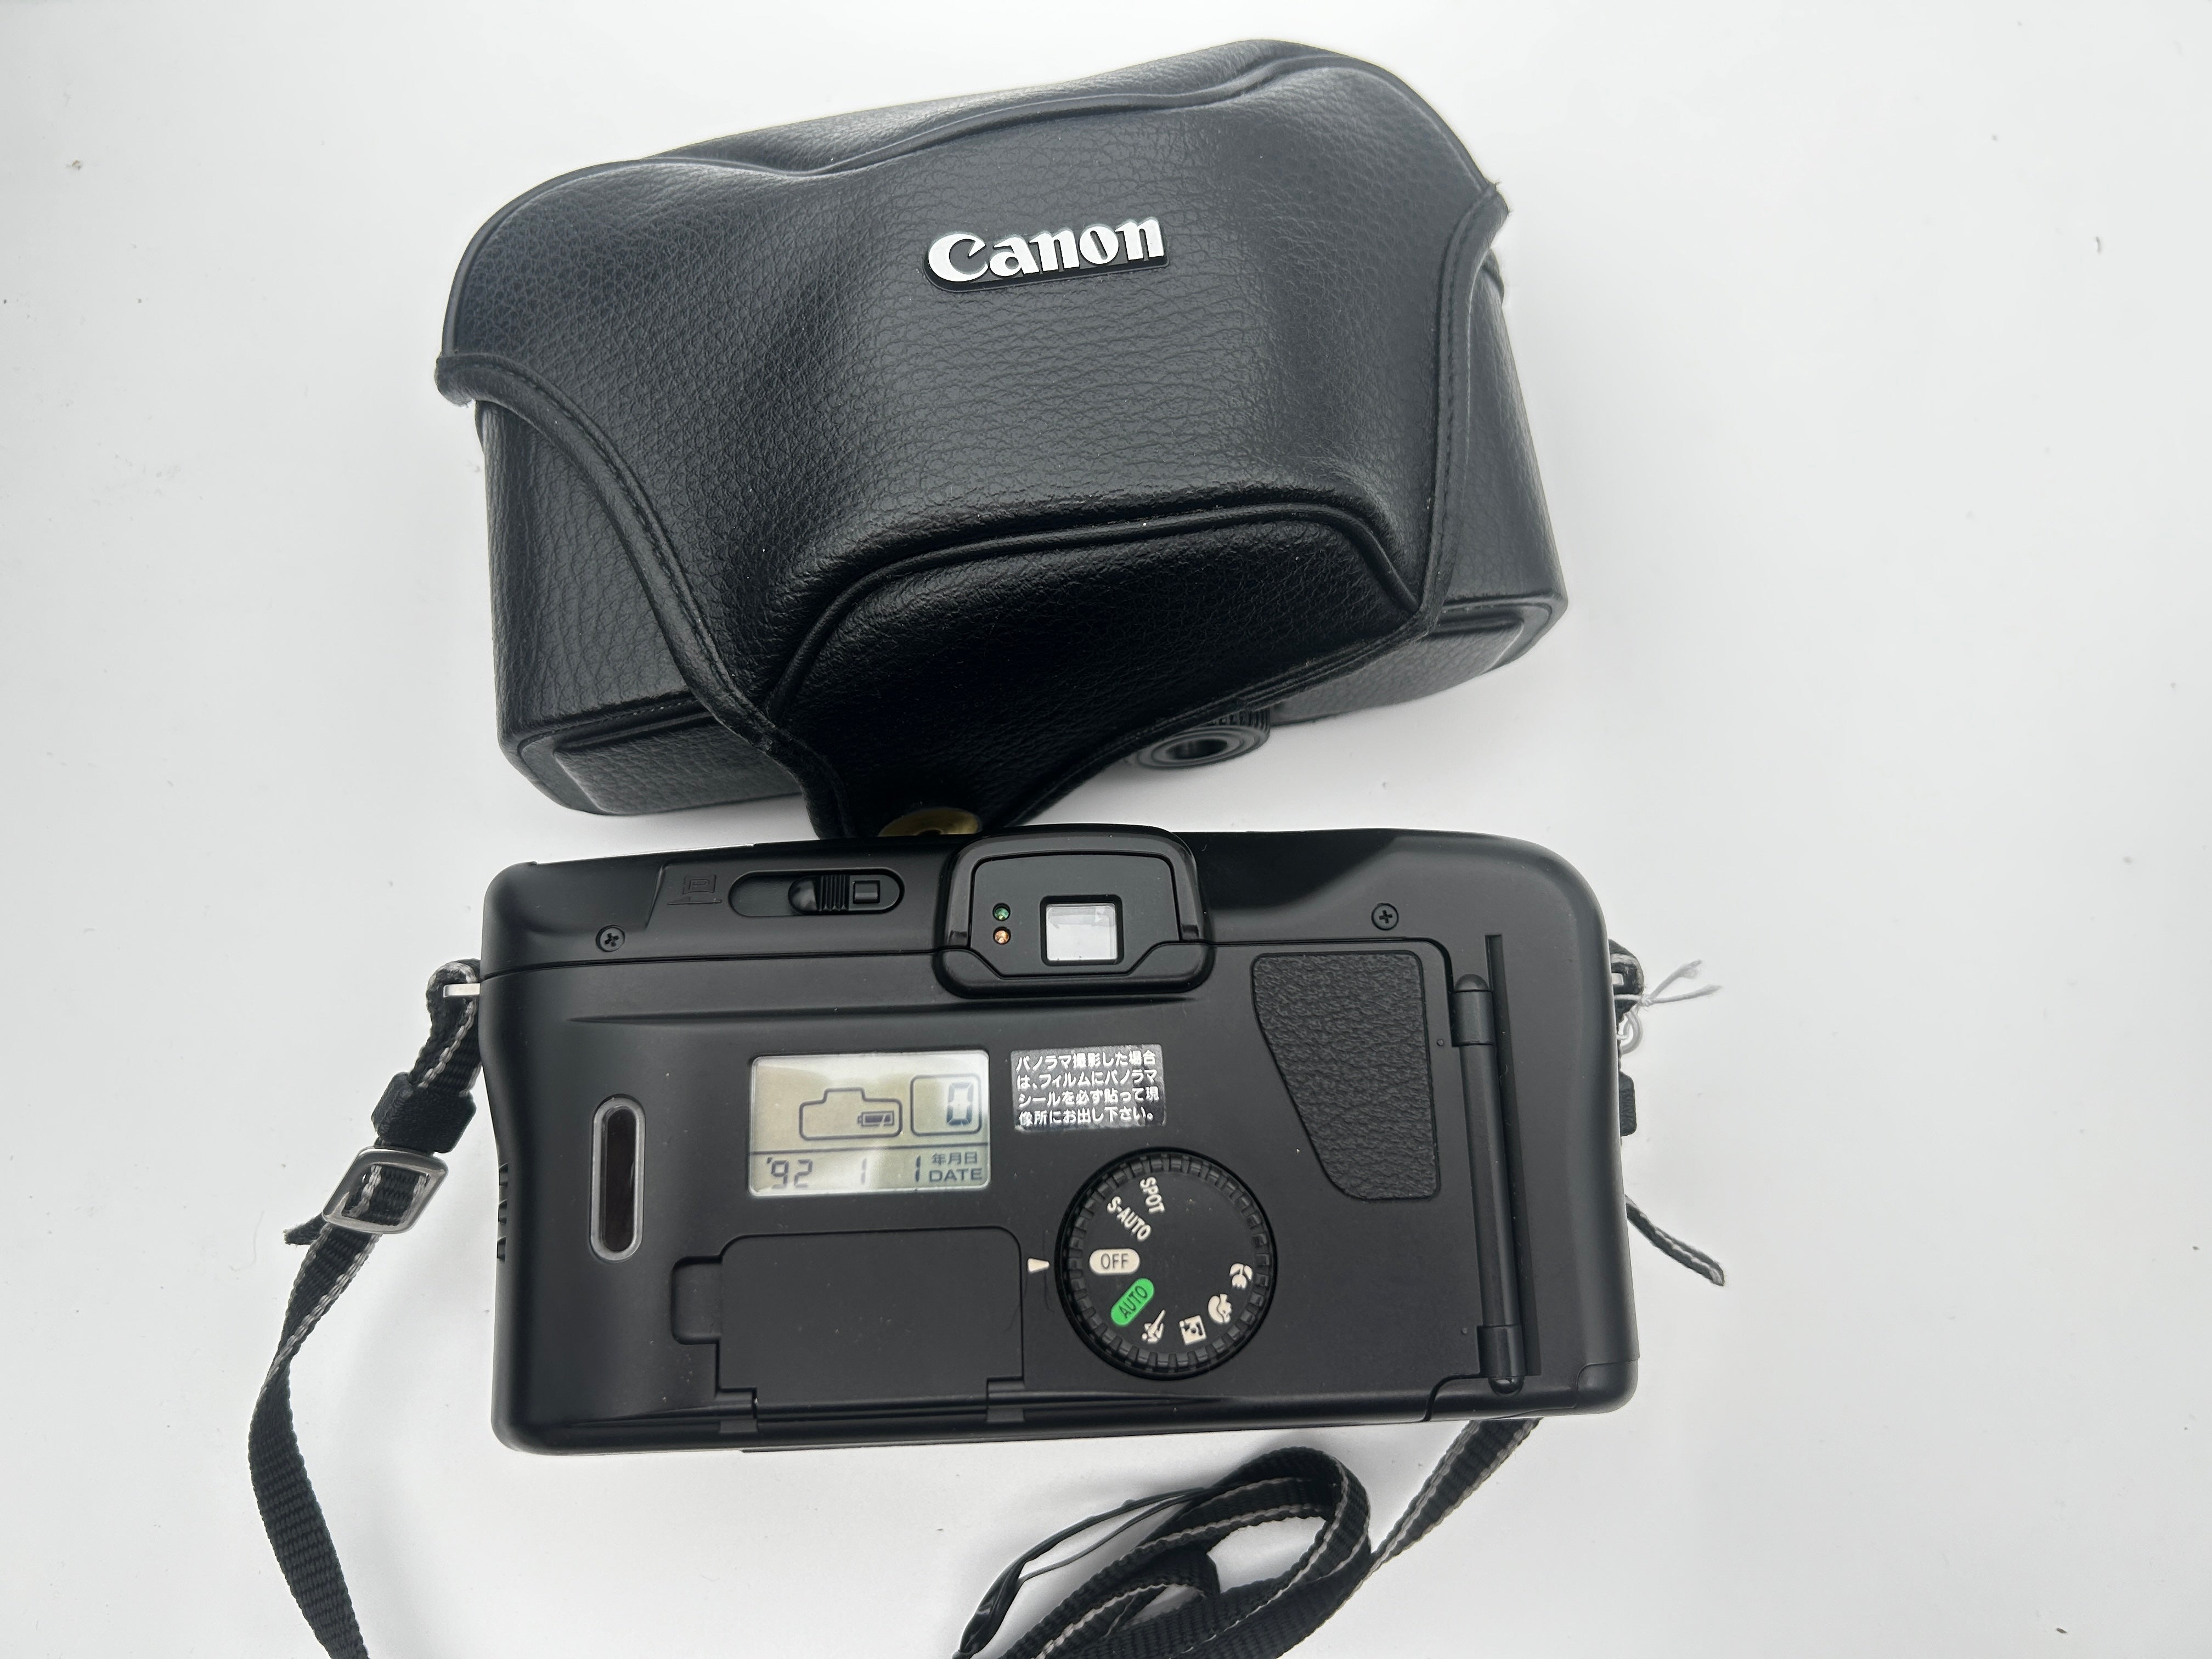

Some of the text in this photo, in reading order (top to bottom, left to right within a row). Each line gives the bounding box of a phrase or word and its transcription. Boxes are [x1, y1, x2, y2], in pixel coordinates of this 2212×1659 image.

[928, 217, 1165, 282] Canon
[1016, 1049, 1156, 1071] パノラマ撮影した場合
[946, 1081, 974, 1126] 0
[1018, 1086, 1160, 1108] シールを必ず貼って現
[860, 1158, 867, 1184] 1
[915, 1155, 921, 1182] 1
[932, 1152, 977, 1165] 年月日
[929, 1167, 982, 1182] DATE
[1139, 1176, 1165, 1214] SPOT
[1107, 1195, 1152, 1242] S-AUTO
[1101, 1253, 1128, 1269] OFF
[1118, 1285, 1148, 1318] AUTO
